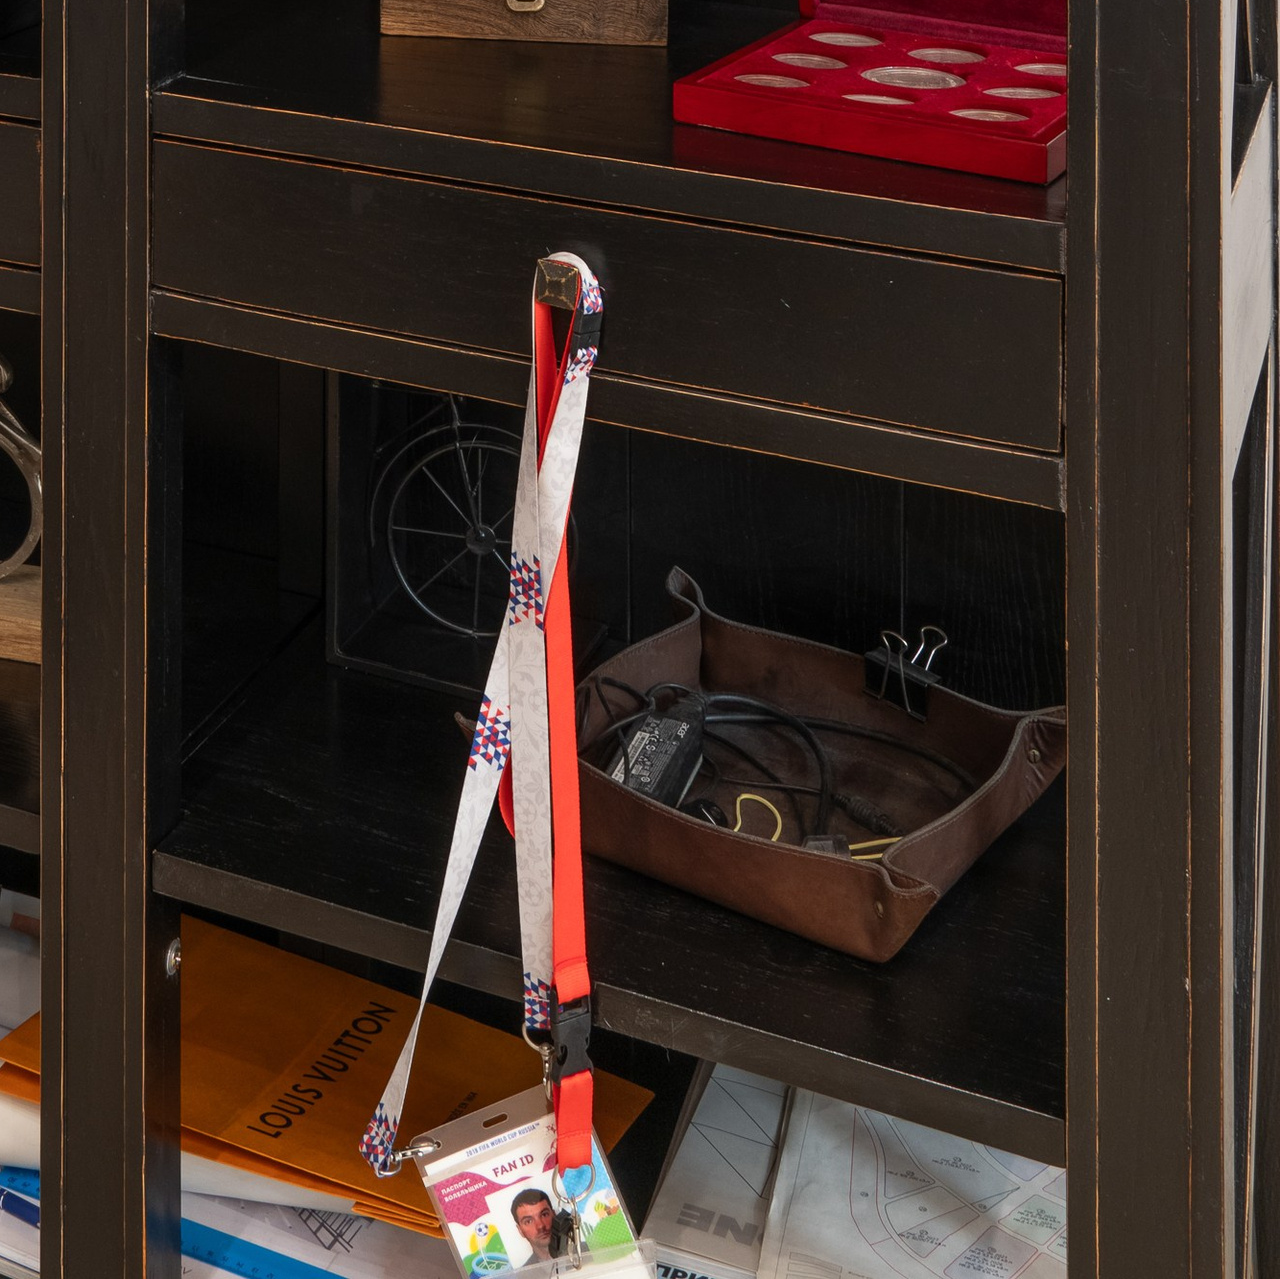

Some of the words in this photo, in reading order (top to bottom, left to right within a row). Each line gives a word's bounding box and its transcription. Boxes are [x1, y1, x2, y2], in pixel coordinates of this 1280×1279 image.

[246, 1084, 323, 1138] LOUIS
[302, 1001, 399, 1087] VUITTON
[467, 1148, 478, 1158] 2018
[477, 1144, 490, 1153] FIFA
[490, 1135, 508, 1148] WORLD
[492, 1159, 518, 1178] FAN
[520, 1153, 534, 1172] ID
[441, 1178, 471, 1196] ПАСПОРТ
[444, 1180, 488, 1203] БОЛЕЛЬЩИКА
